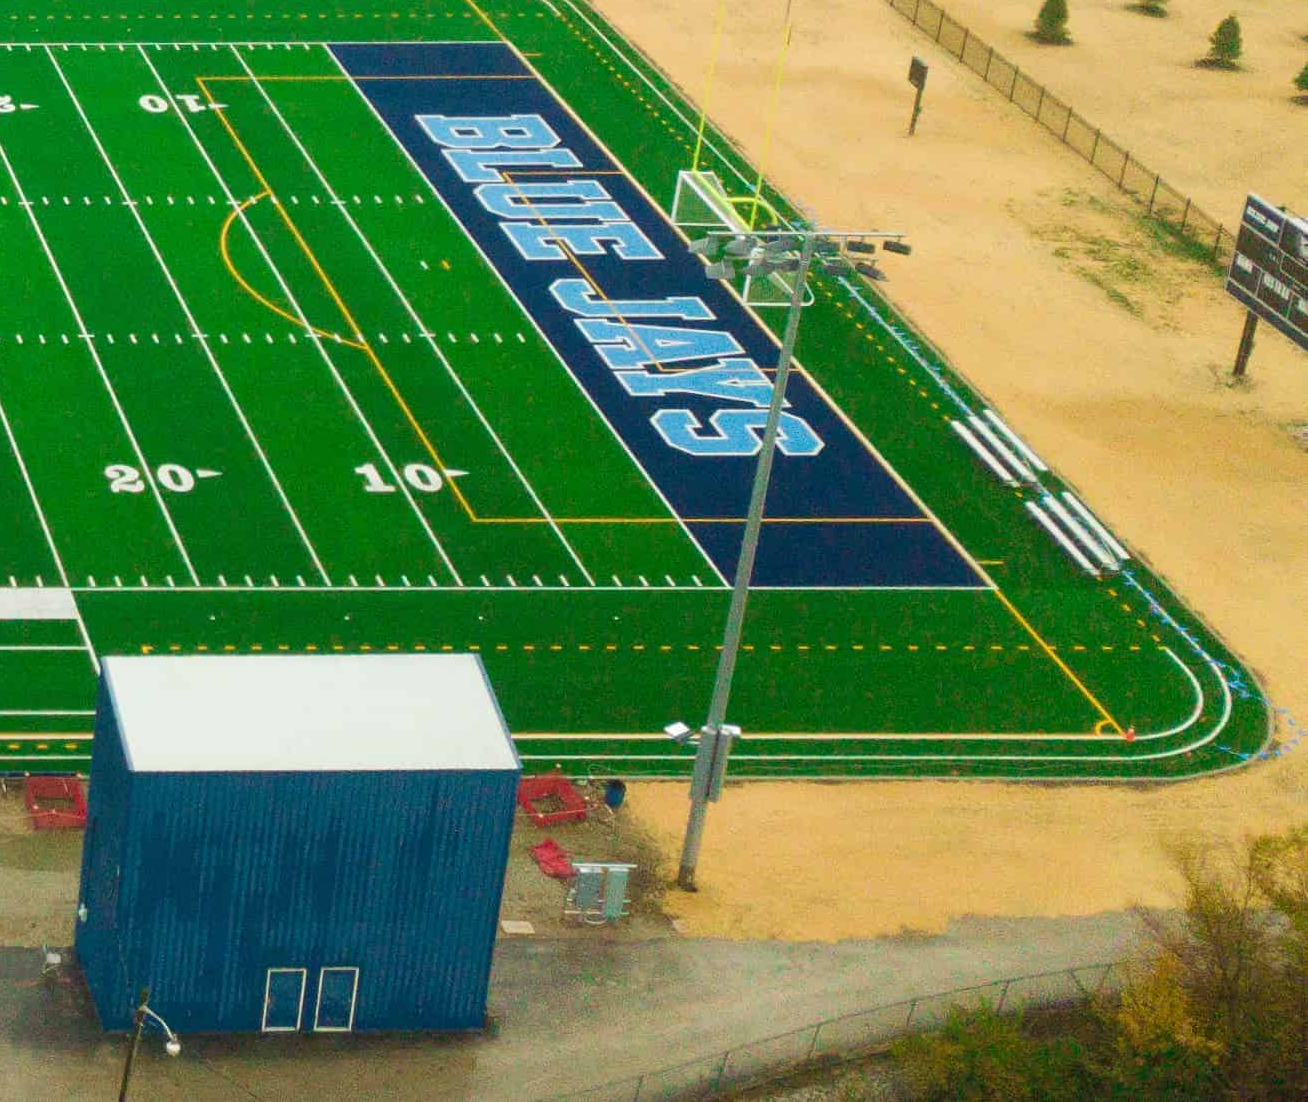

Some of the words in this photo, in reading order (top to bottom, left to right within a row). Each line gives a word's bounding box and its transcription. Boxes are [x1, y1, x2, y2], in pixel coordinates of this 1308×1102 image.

[139, 95, 206, 113] 10
[414, 113, 665, 260] BLUE
[549, 277, 826, 458] JAYS
[105, 464, 194, 493] 20
[355, 464, 442, 492] 10
